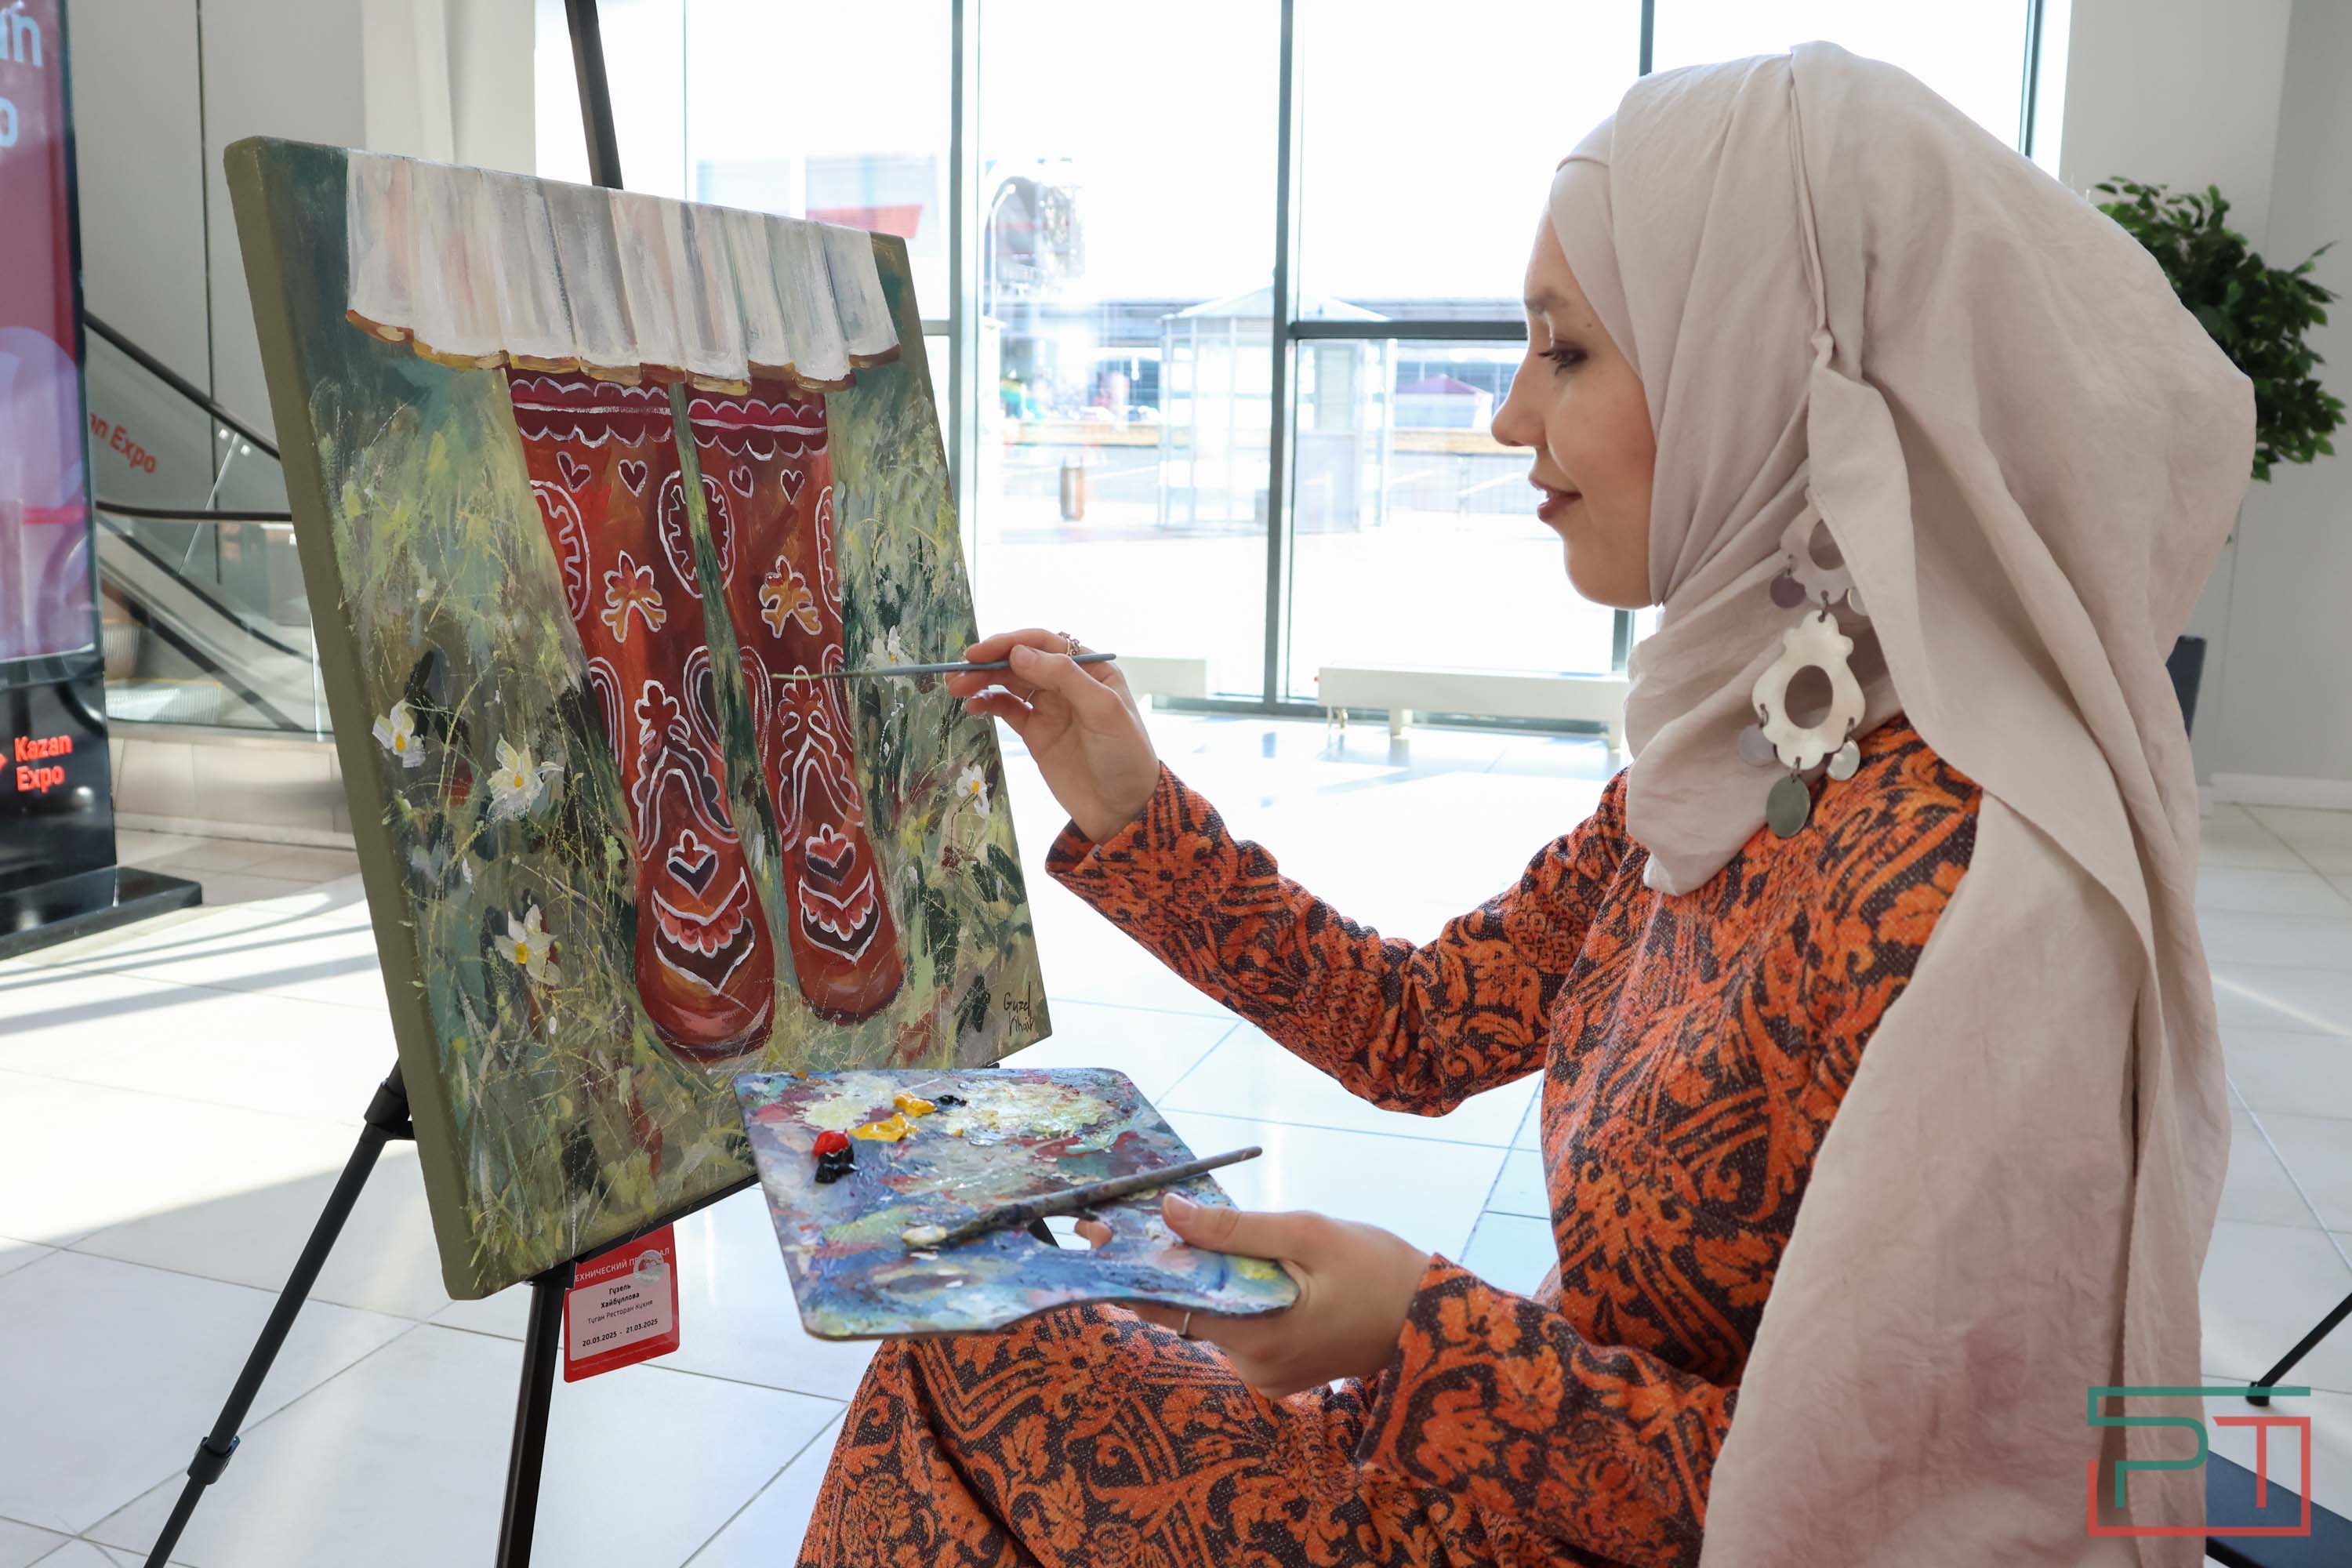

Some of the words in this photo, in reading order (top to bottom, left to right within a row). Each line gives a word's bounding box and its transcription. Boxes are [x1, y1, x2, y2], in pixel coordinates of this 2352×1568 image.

[110, 426, 157, 474] Expo
[14, 735, 73, 762] Kazan
[16, 765, 65, 794] Expo
[575, 1259, 628, 1283] ЕХНИЧЕСКИЙ
[601, 1292, 640, 1309] Хайбуллова
[608, 1283, 631, 1295] Гузель
[606, 1306, 634, 1319] Ресторан
[583, 1330, 617, 1347] 20.03.2025
[626, 1318, 658, 1334] 21.03.2025
